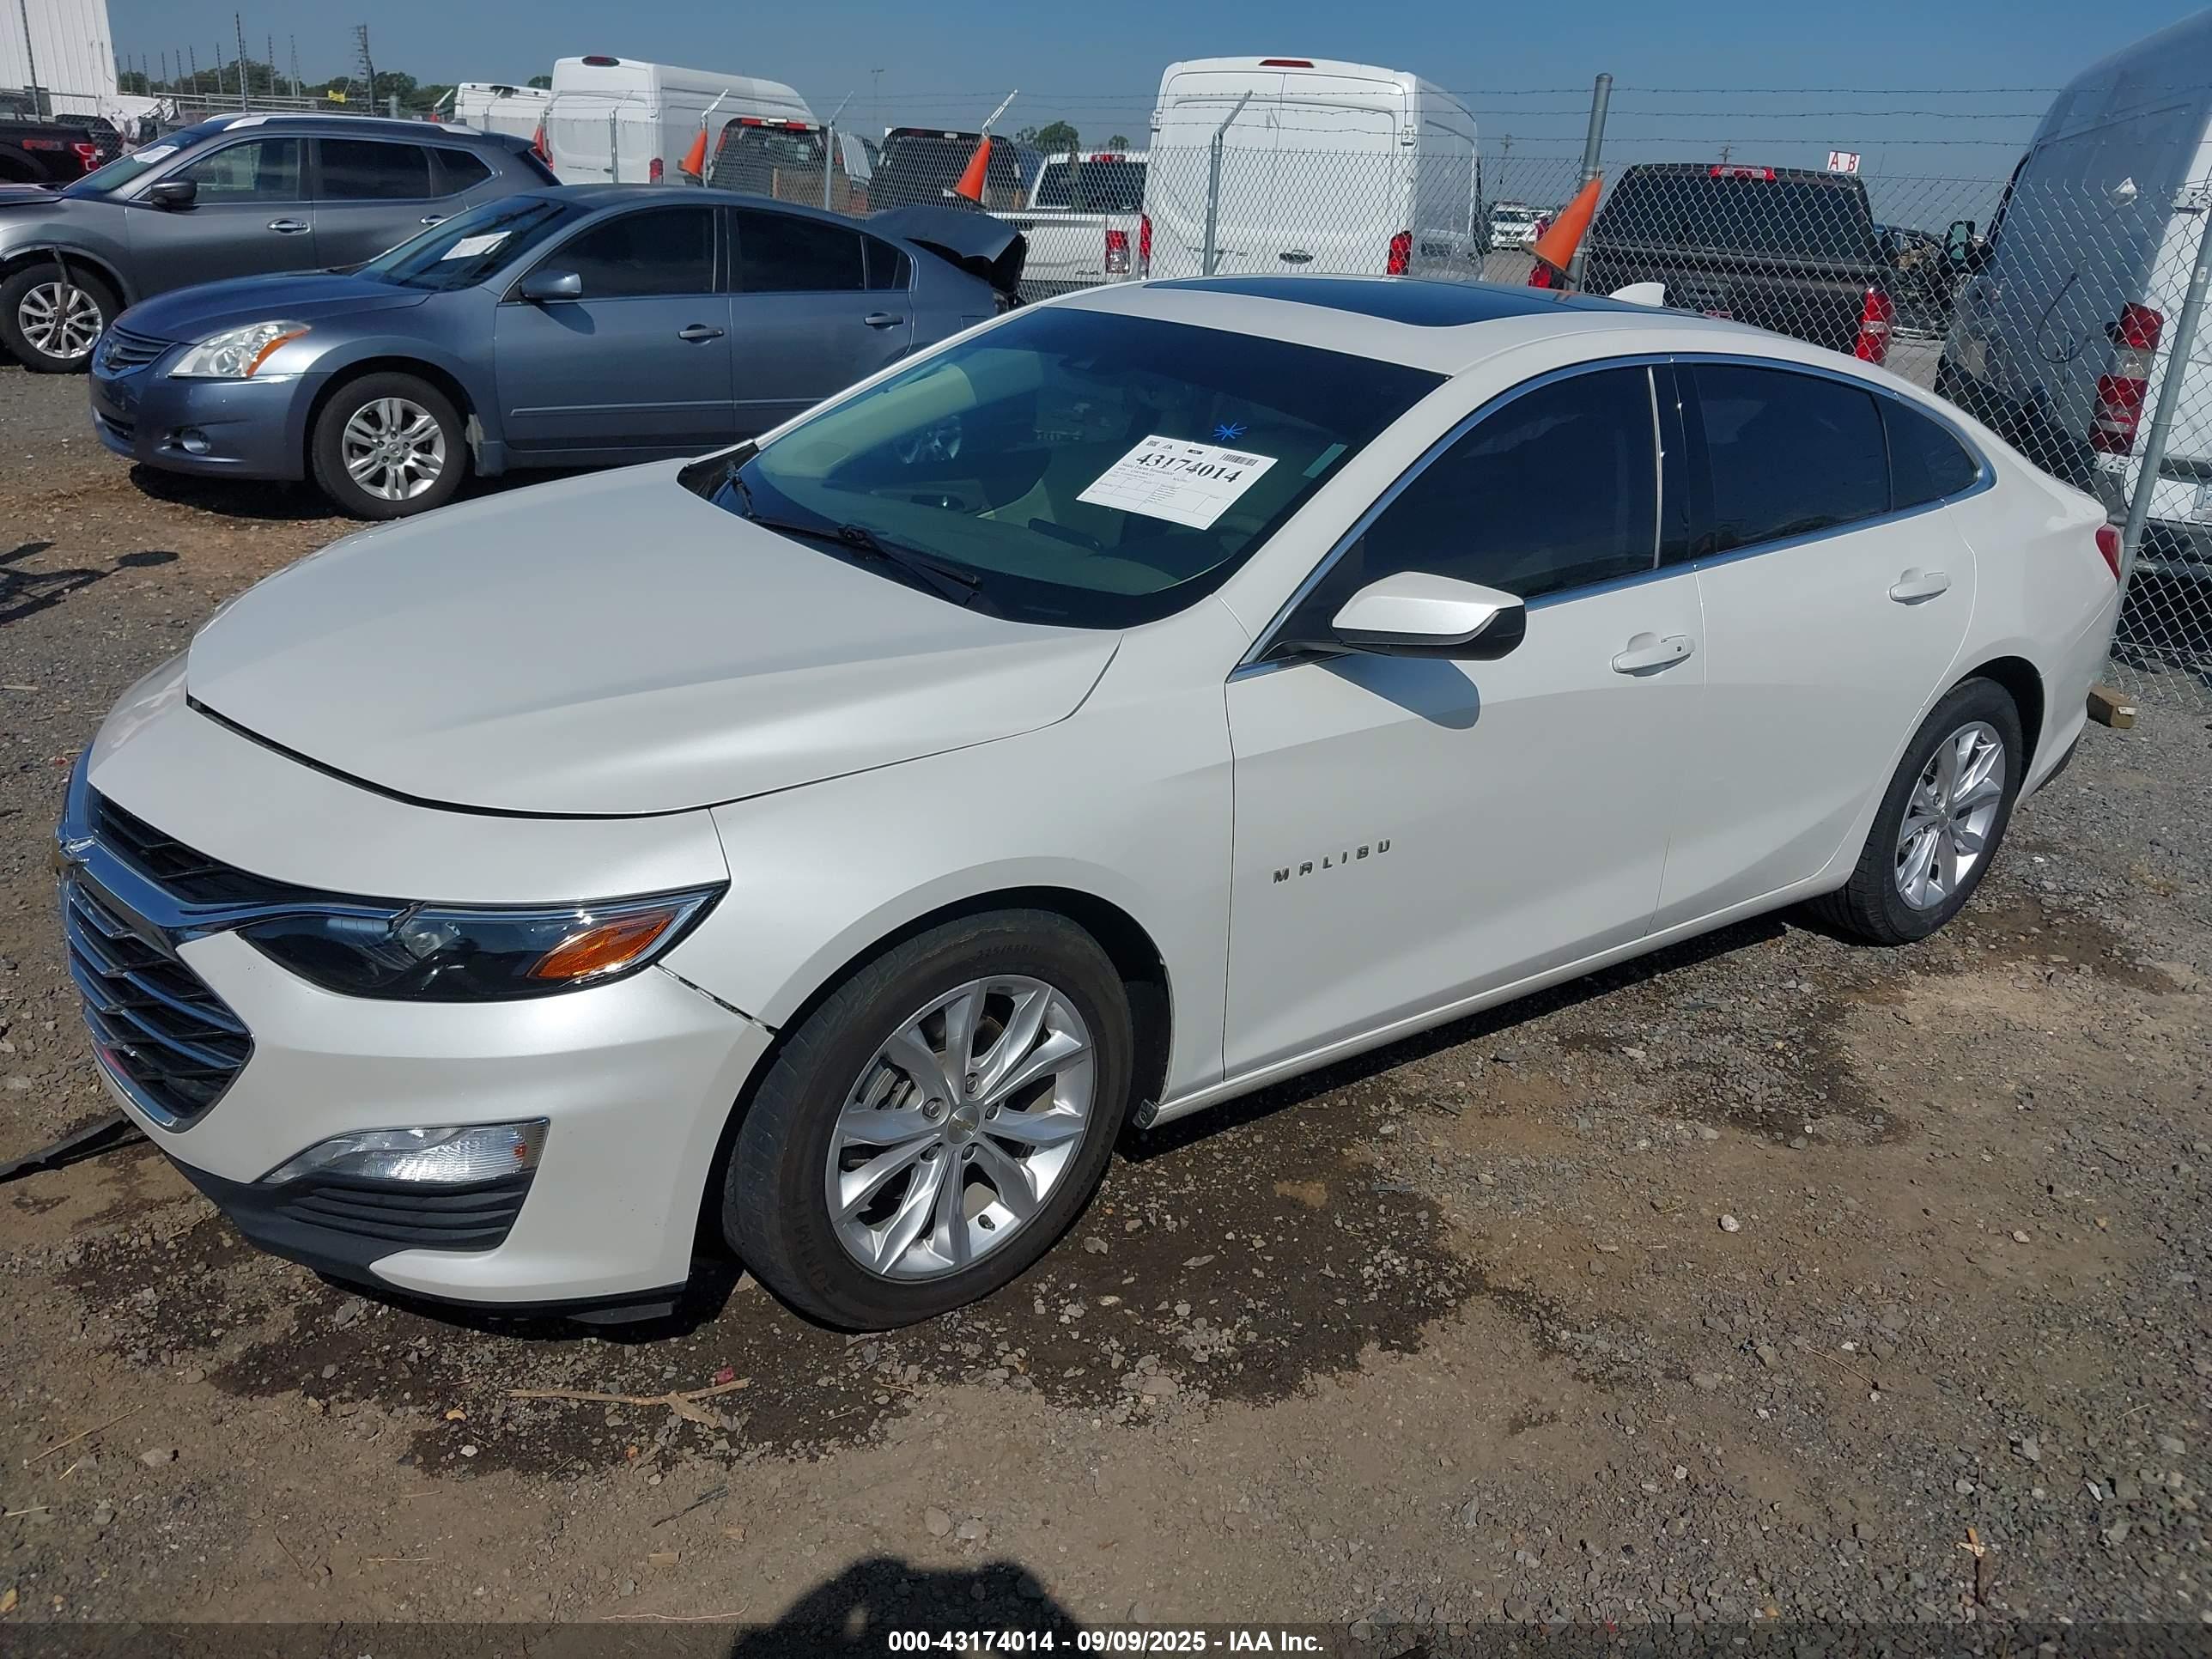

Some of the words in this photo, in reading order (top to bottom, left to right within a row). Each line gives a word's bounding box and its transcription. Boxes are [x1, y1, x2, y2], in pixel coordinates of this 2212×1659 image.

[1829, 152, 1839, 170] A
[1848, 153, 1857, 172] B
[1136, 453, 1243, 483] 43174014
[1273, 839, 1392, 884] MALIBU
